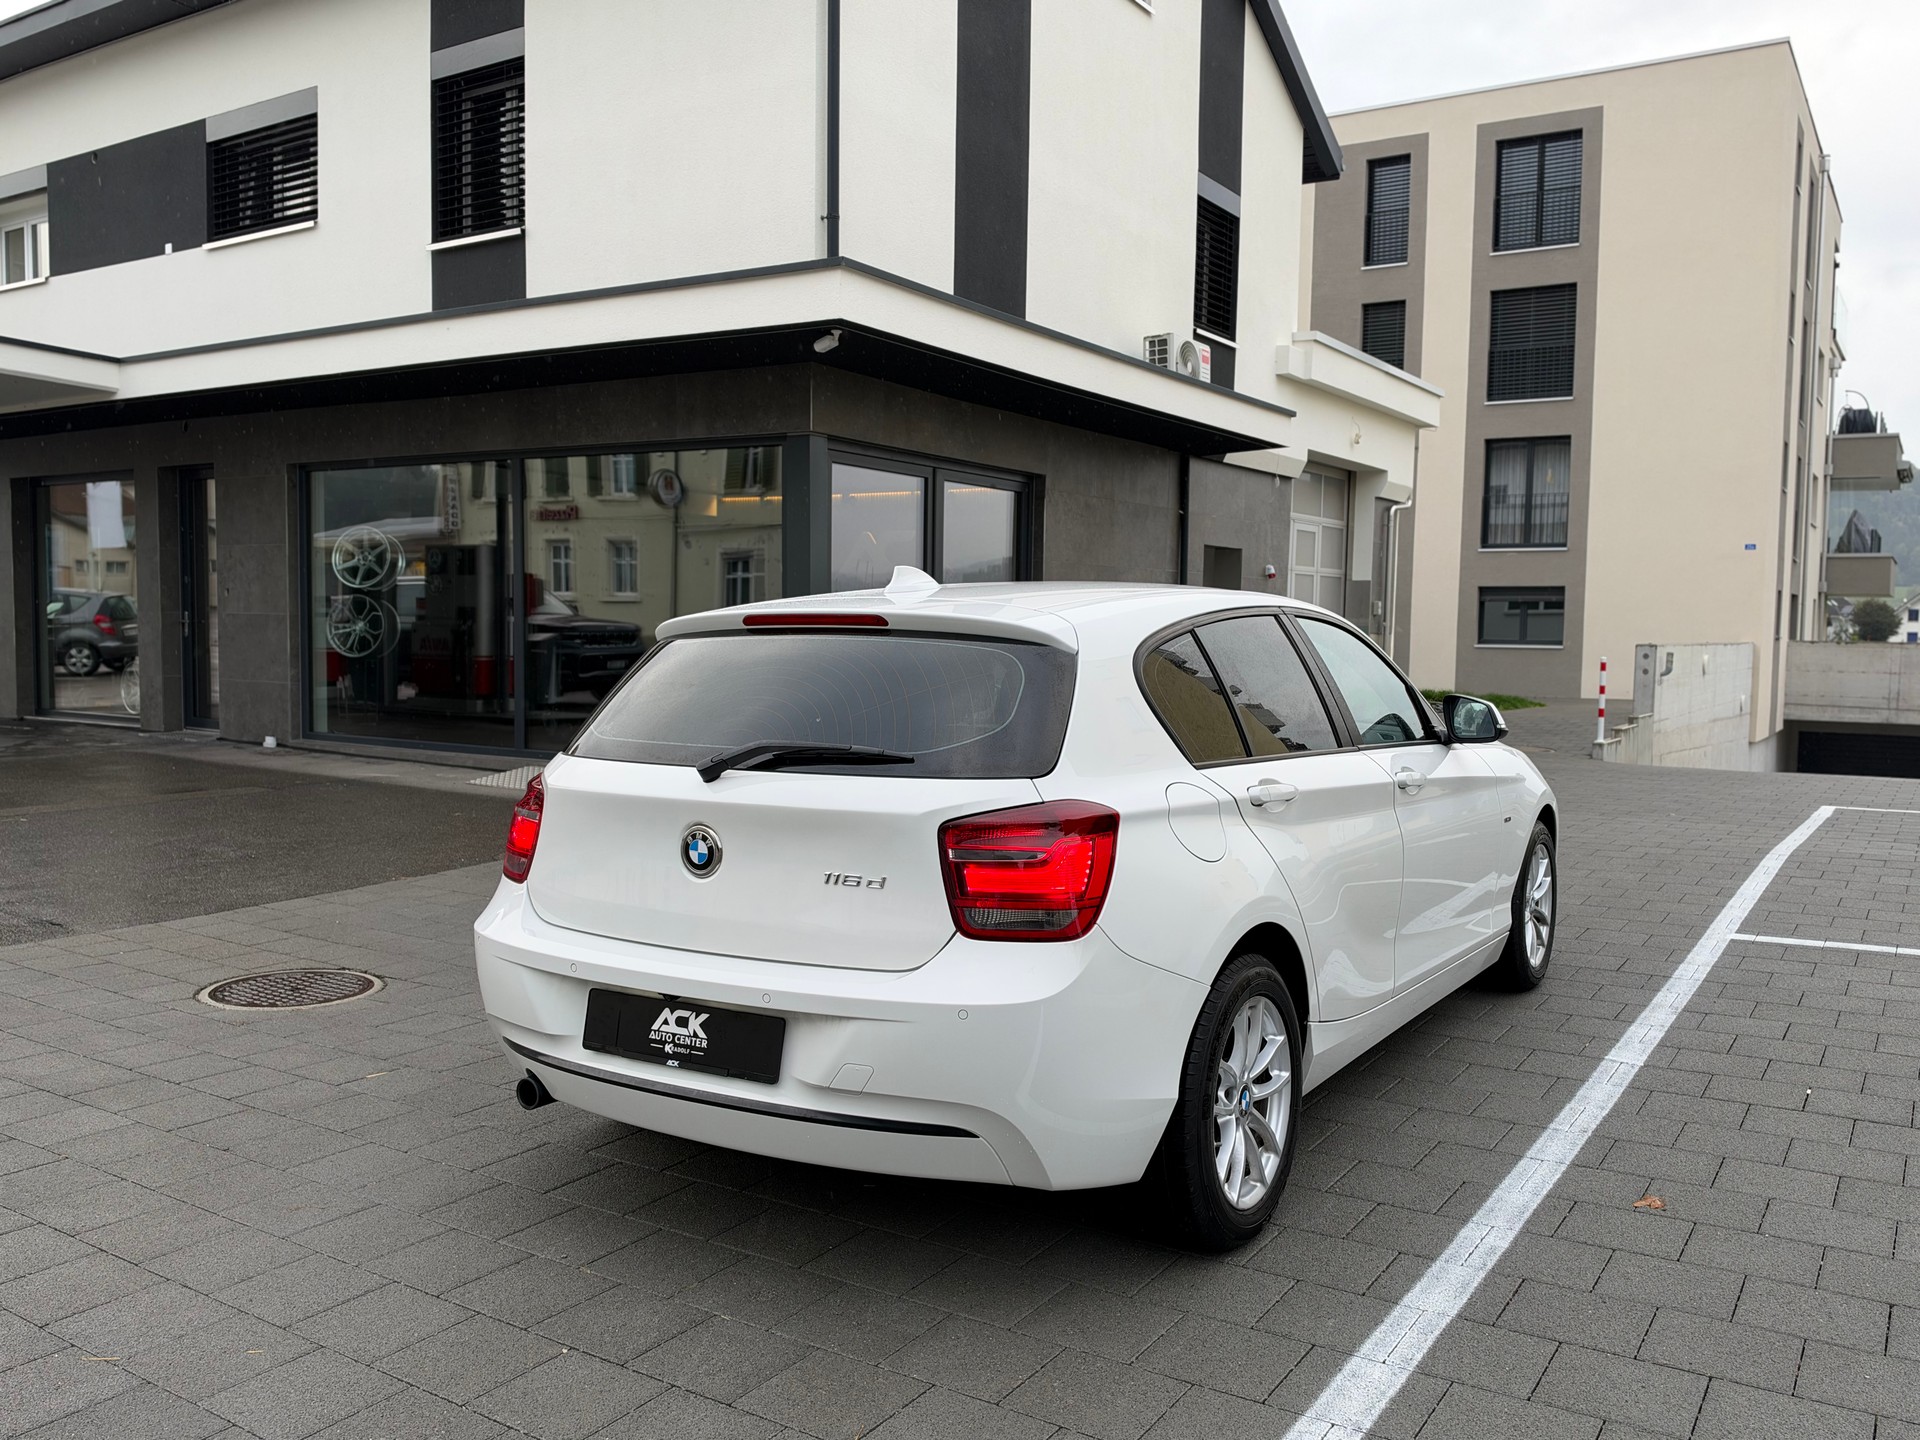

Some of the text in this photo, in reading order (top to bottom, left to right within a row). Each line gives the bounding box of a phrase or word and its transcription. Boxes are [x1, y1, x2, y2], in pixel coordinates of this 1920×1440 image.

[687, 832, 713, 848] BMW
[650, 1007, 710, 1039] ACK
[648, 1030, 708, 1049] AUTO CENTER
[666, 1059, 680, 1068] ACK
